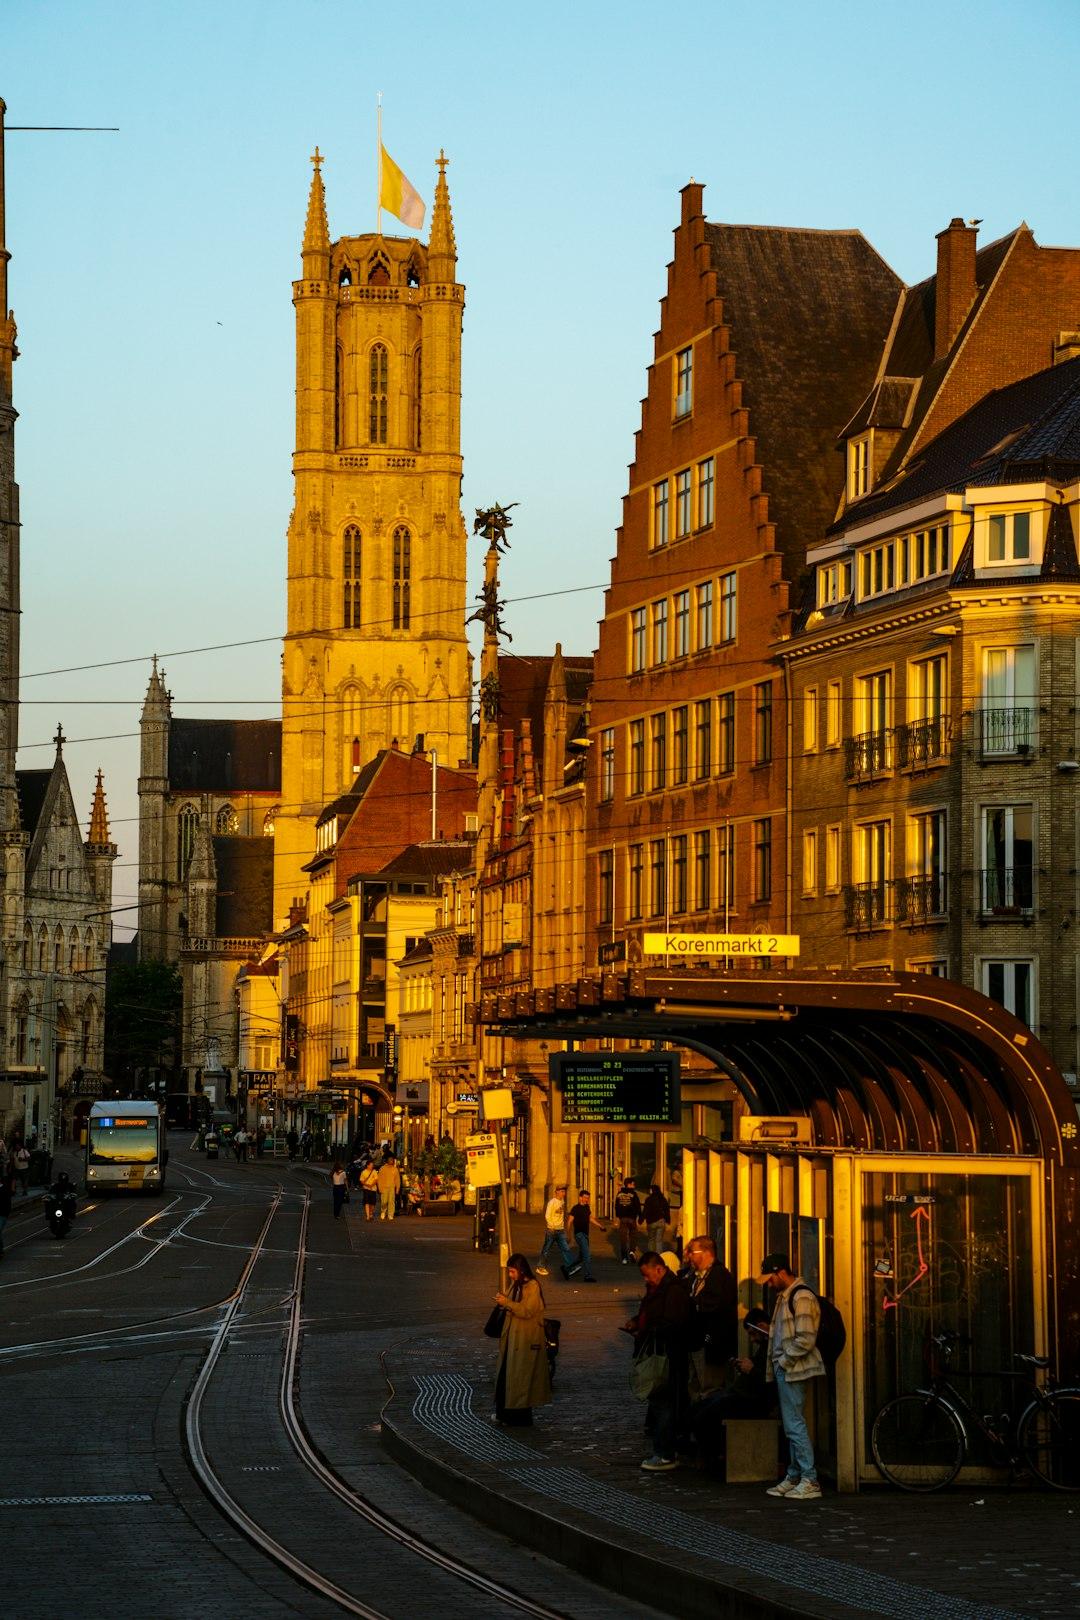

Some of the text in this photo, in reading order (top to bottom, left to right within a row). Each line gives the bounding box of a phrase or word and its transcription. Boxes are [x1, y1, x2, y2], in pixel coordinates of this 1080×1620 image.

[666, 937, 778, 953] Korenmarkt 2
[387, 1031, 395, 1068] Leonidas
